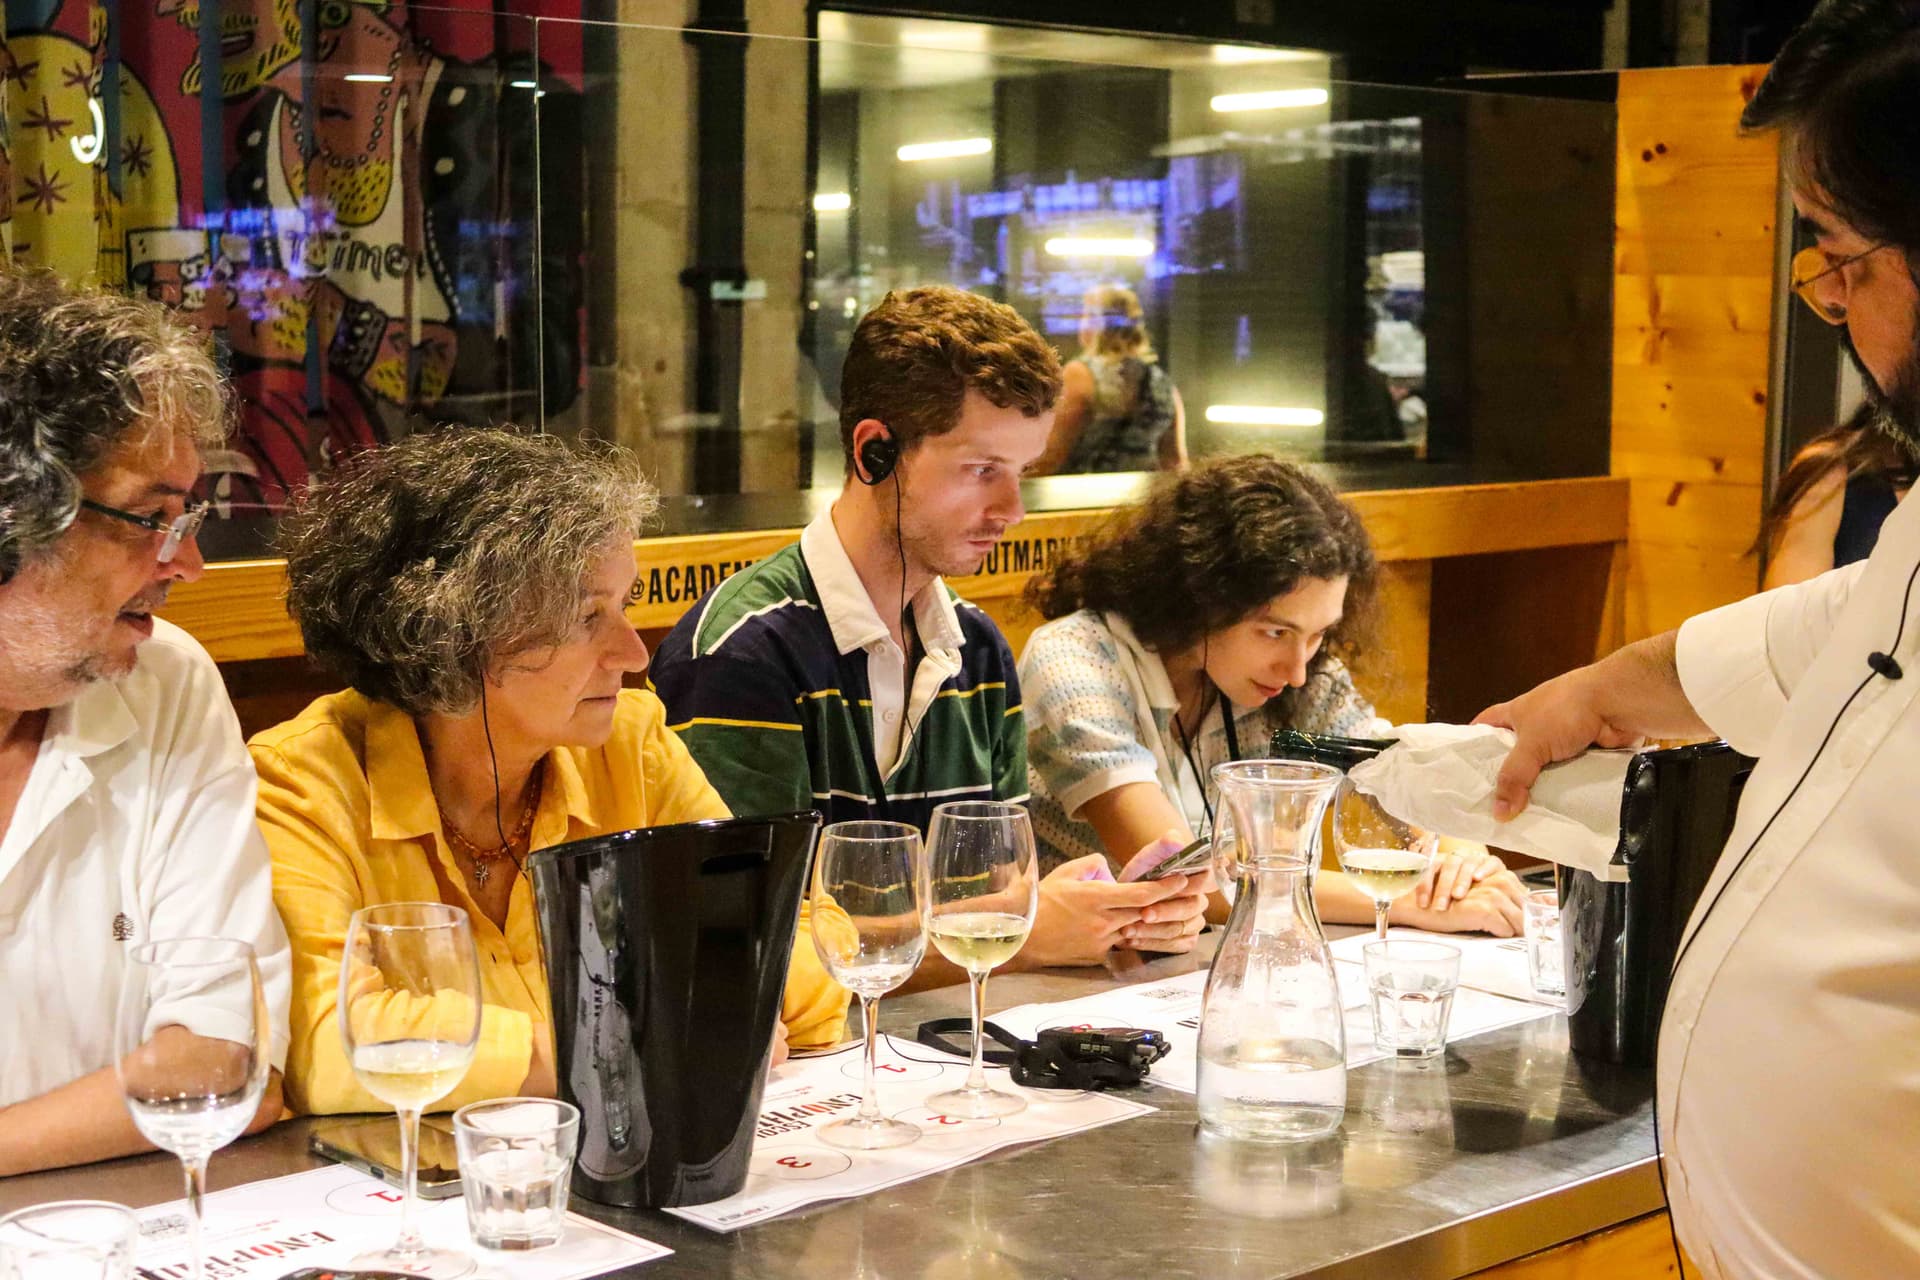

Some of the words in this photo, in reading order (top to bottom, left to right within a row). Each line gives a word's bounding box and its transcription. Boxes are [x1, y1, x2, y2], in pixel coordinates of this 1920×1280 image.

[876, 1063, 907, 1074] 1
[927, 1115, 962, 1126] 2
[775, 1156, 812, 1169] 3
[365, 1190, 403, 1202] 1
